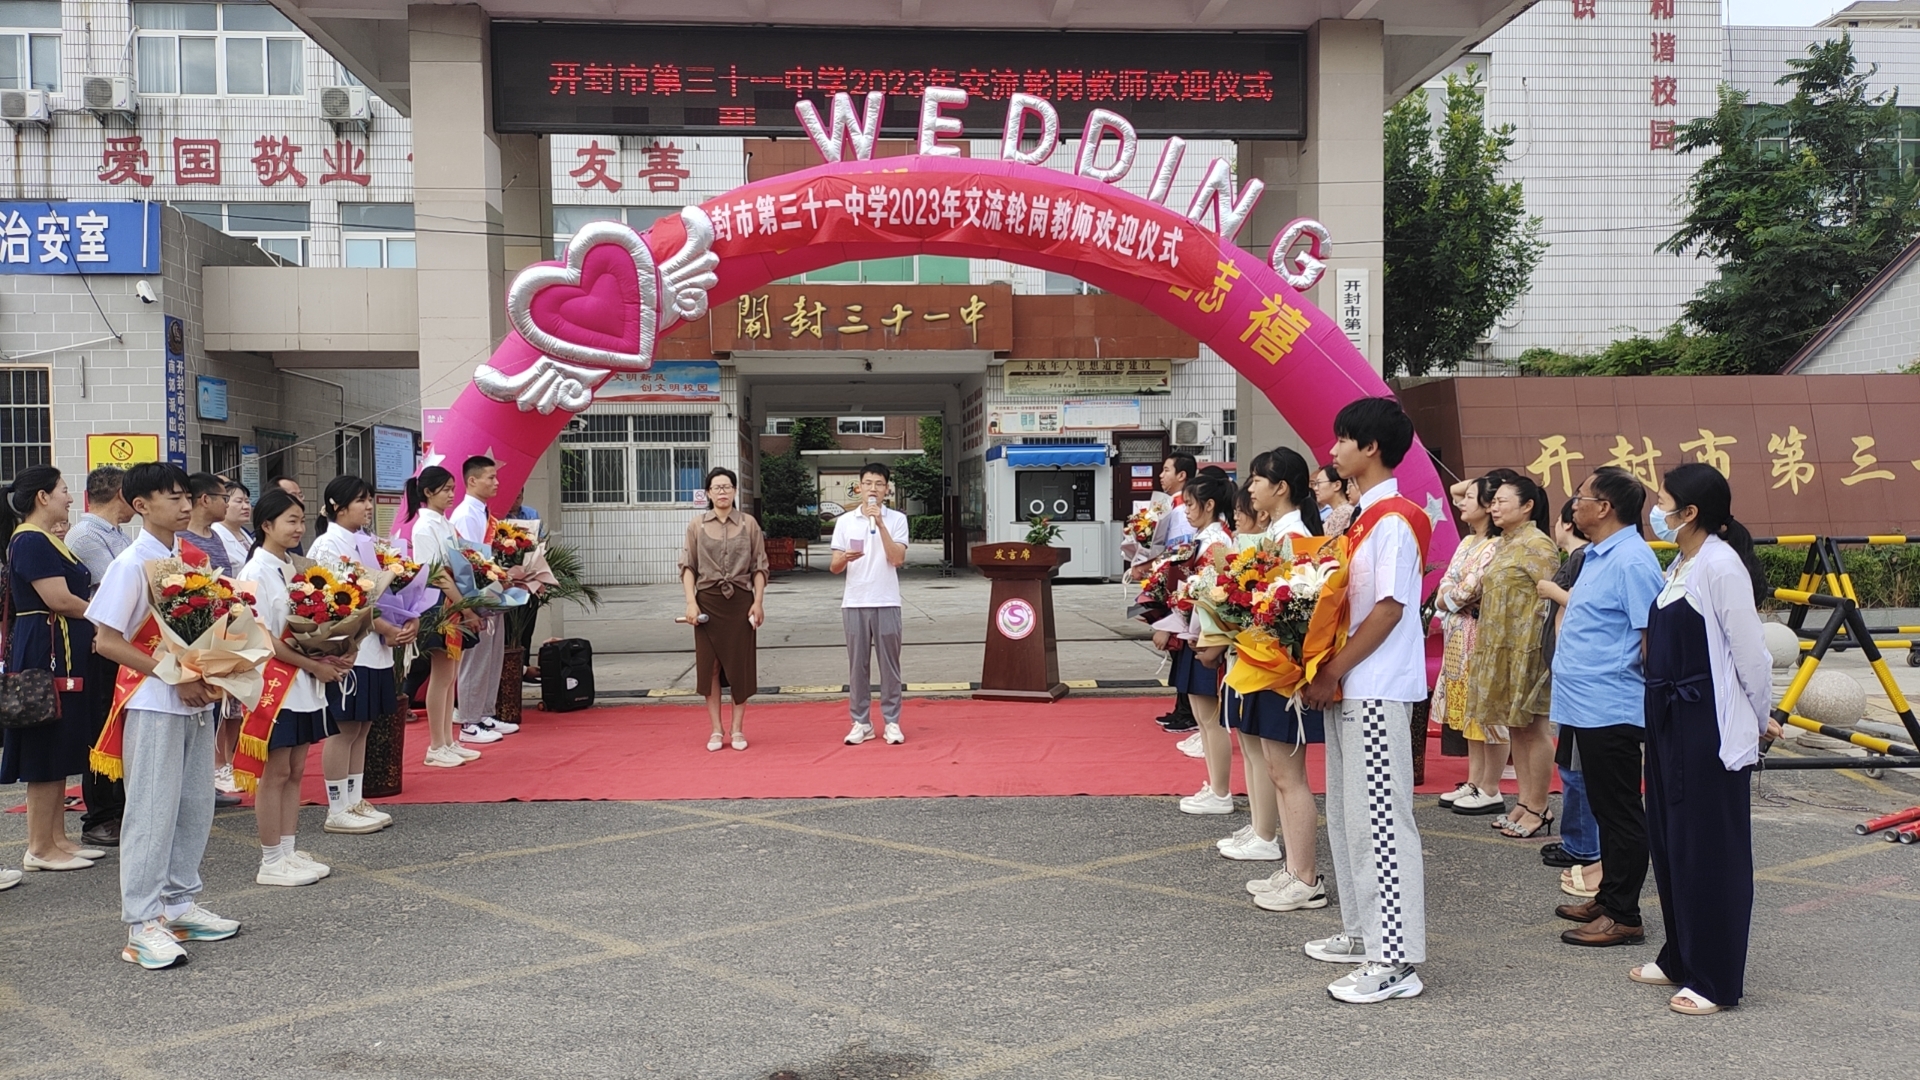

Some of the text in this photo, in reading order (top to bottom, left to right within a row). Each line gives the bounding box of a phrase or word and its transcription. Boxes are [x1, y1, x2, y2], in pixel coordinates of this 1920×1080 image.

[548, 62, 1275, 102] 开封市第三十一中学2023年交流轮岗教师欢迎仪式
[1650, 0, 1678, 151] 和谐校园
[98, 135, 372, 188] 爱国敬业
[569, 140, 691, 193] 友善
[795, 86, 1333, 290] WEDDING
[0, 209, 110, 264] 治安室
[706, 184, 1184, 269] 封市第三十一中学2023年交流轮岗教师欢迎仪式
[640, 383, 708, 392] 创文明校园
[1024, 360, 1151, 371] 未成年人思想道德建设
[176, 360, 186, 454] 开封市公安局
[1526, 425, 1920, 496] 开封市第三
[994, 547, 1031, 561] 发言席
[259, 665, 288, 708] 一中学
